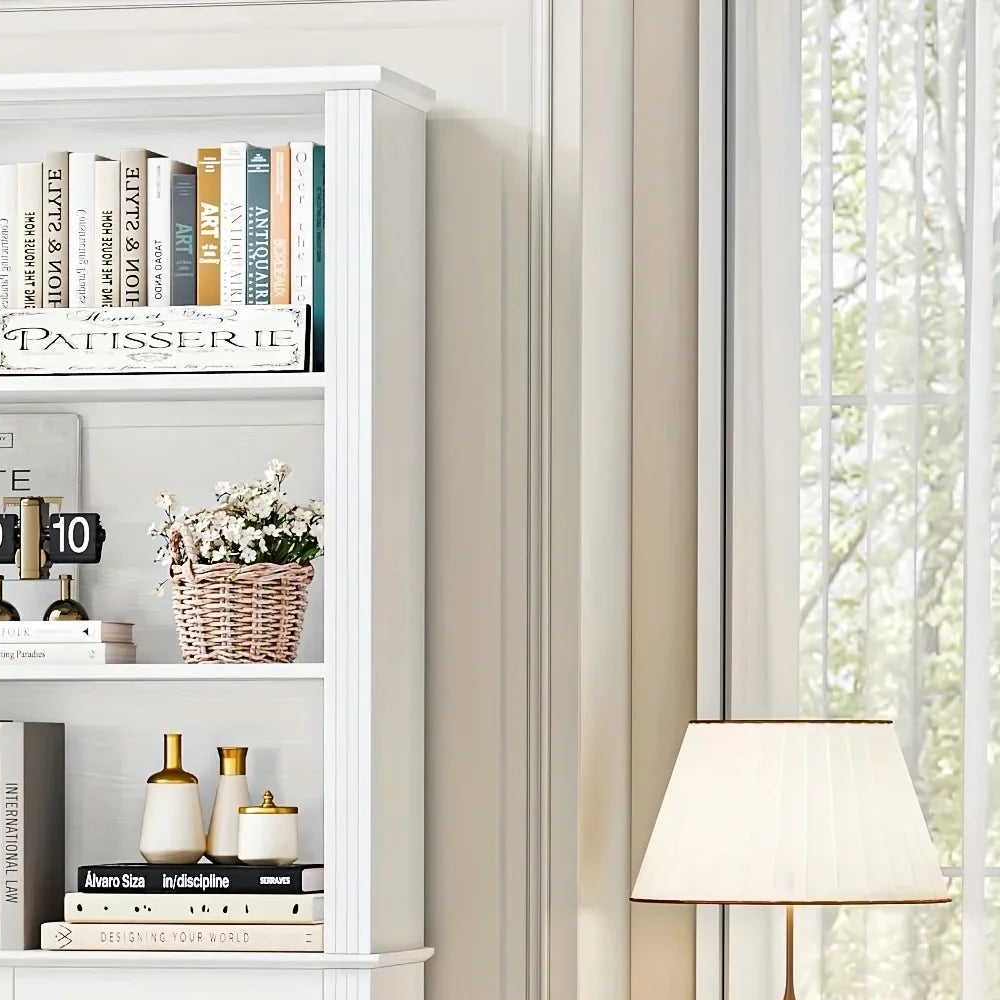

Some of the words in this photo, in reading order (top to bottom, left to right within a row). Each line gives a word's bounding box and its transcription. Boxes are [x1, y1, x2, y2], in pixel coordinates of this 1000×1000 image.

[200, 202, 219, 238] ART
[176, 222, 192, 254] ART
[4, 327, 297, 352] PATISSERIE
[52, 516, 90, 553] 10
[5, 783, 18, 875] INTERNATIONAL
[5, 880, 18, 904] LAW
[85, 870, 120, 888] Álvaro
[122, 873, 145, 888] Siza
[163, 873, 230, 890] in/discipline
[100, 931, 166, 943] DESIGNING
[172, 931, 204, 943] YOUR
[210, 932, 250, 943] WORLD
